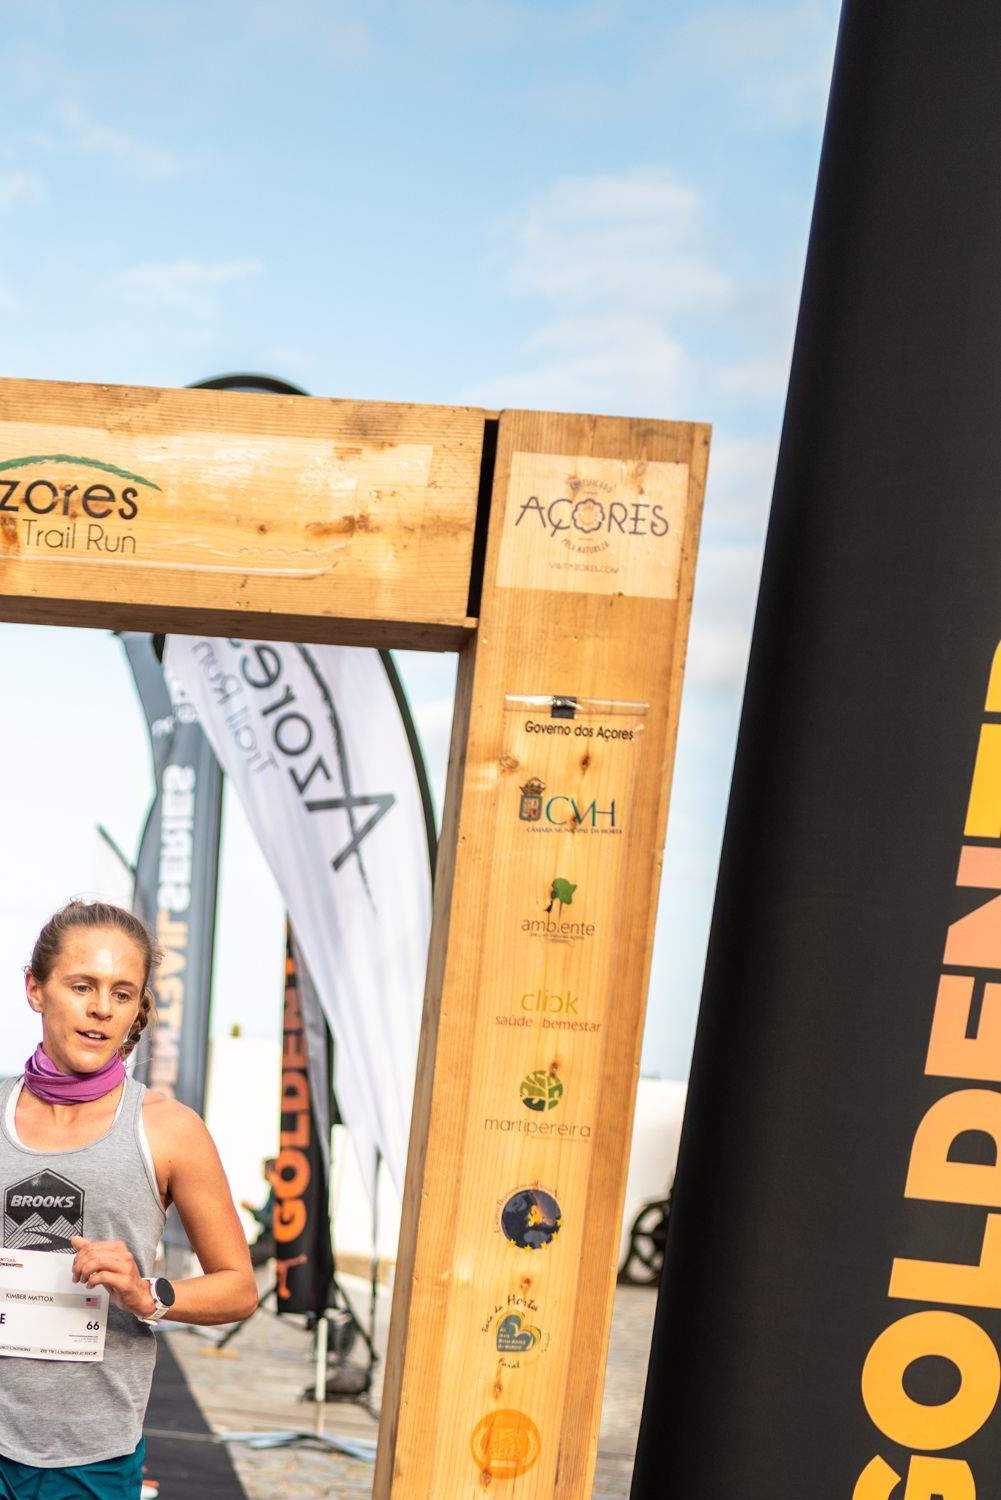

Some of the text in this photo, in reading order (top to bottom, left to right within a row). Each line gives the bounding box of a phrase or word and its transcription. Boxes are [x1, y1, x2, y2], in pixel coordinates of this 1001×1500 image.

[515, 496, 669, 538] AÇORES
[22, 518, 136, 554] Trail Run
[525, 720, 634, 742] Governo dos Açores
[484, 1117, 591, 1138] martipereira
[10, 1194, 75, 1208] BROOKS
[6, 1293, 54, 1303] KIMBER MATTOX
[86, 1321, 100, 1331] 66
